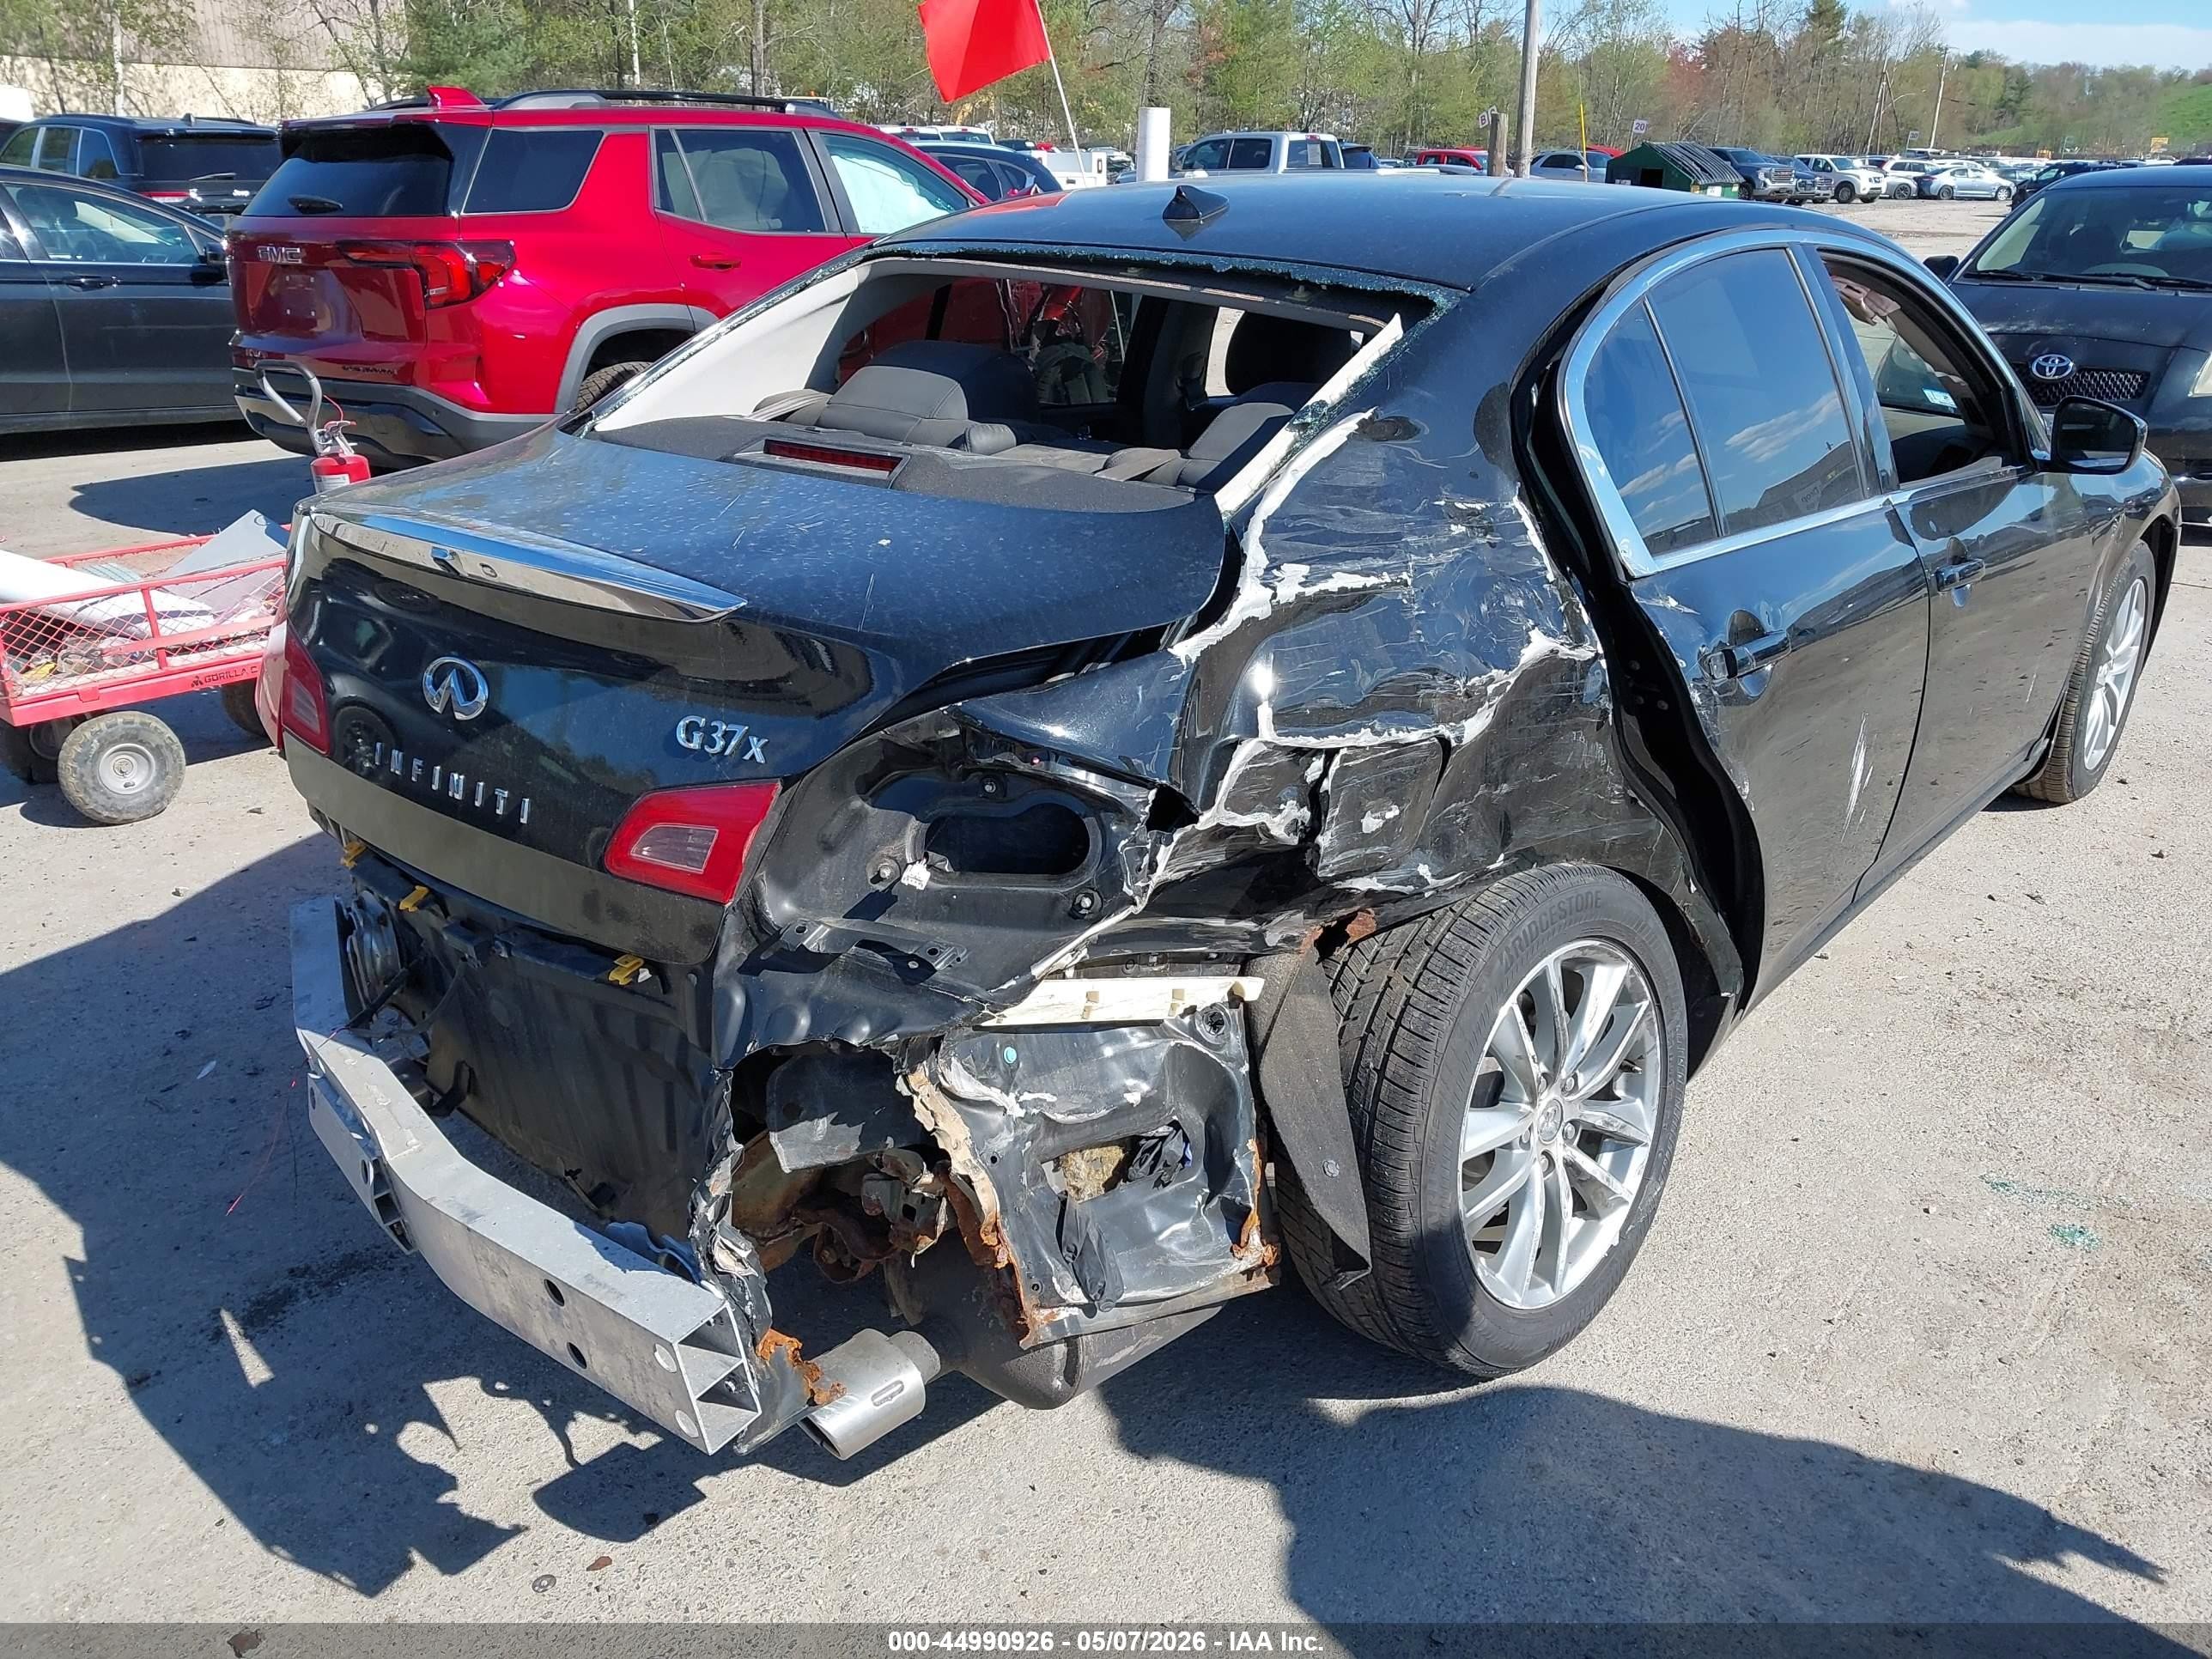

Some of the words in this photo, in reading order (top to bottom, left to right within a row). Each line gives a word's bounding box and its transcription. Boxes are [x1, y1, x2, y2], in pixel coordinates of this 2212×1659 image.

[258, 246, 302, 264] GMC
[204, 669, 248, 684] GORILLA
[374, 741, 532, 824] INFINITI
